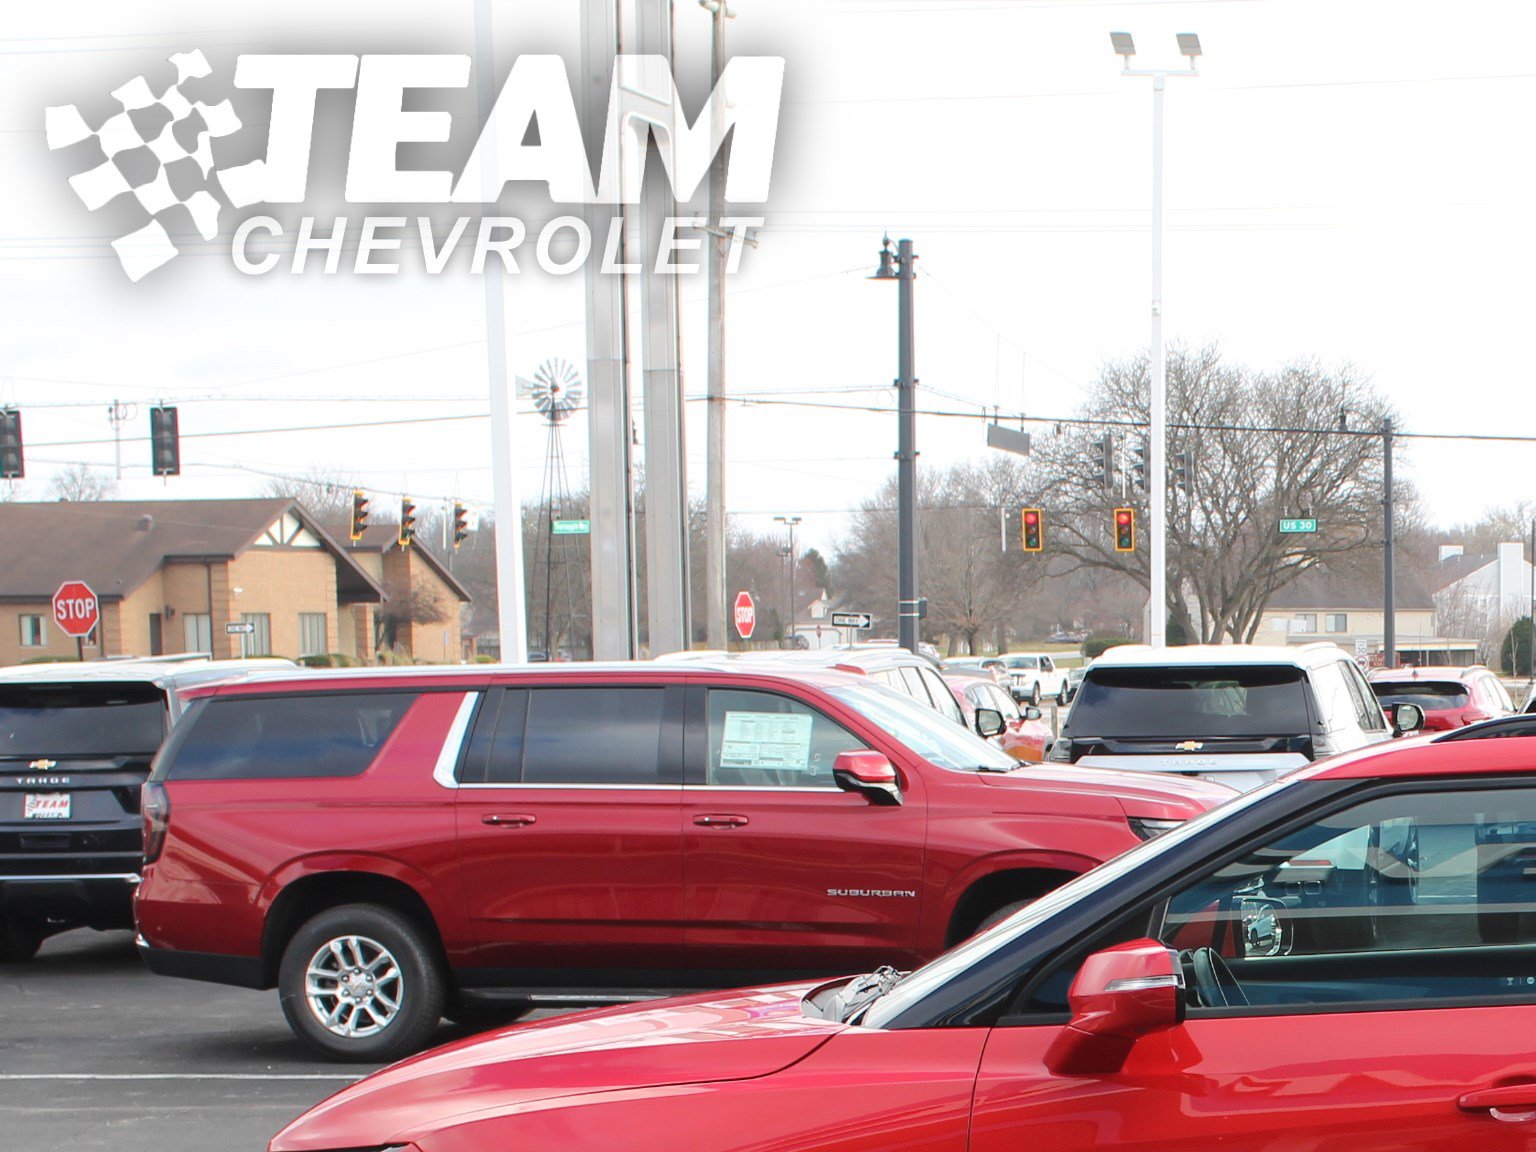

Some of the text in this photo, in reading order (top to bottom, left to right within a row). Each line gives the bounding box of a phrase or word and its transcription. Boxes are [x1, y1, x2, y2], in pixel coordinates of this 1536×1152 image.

[1283, 521, 1312, 530] US 30
[56, 598, 95, 620] STOP
[736, 606, 754, 623] STOP
[16, 776, 70, 784] TAHOE
[35, 800, 69, 809] TEAM
[826, 888, 916, 898] SUBURBAN
